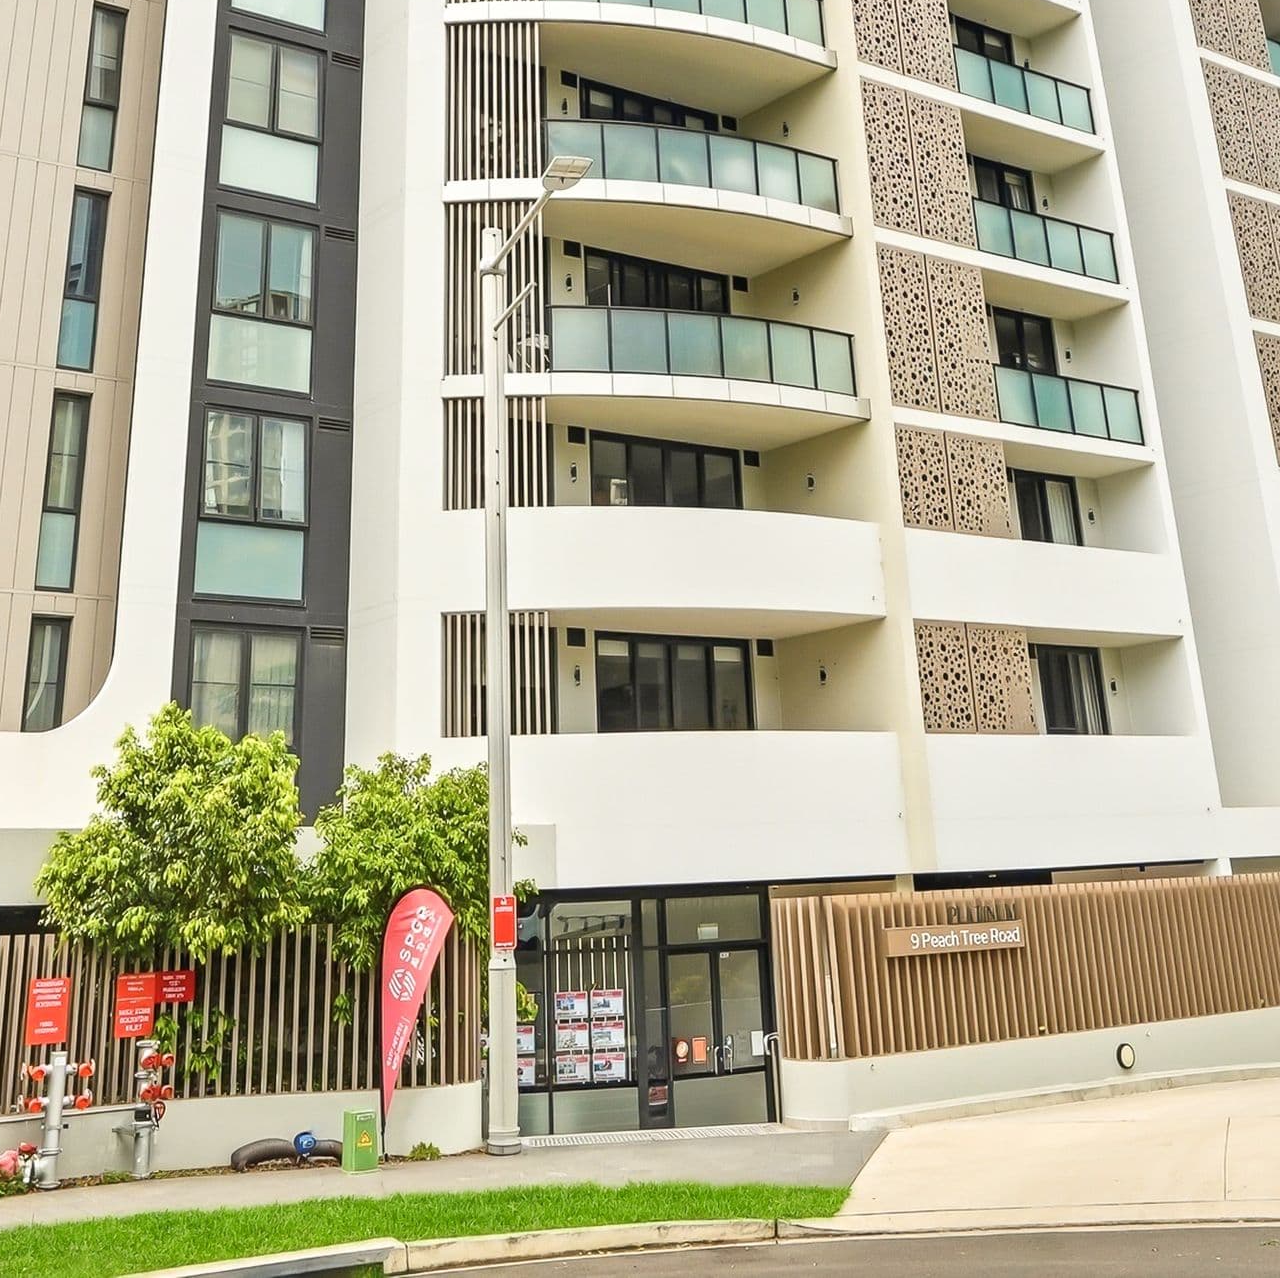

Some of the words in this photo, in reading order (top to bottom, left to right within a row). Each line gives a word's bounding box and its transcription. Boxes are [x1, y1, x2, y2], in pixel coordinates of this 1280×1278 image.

[910, 934, 920, 949] 9
[922, 931, 959, 948] Peach
[959, 929, 988, 946] Tree
[990, 927, 1020, 944] Road
